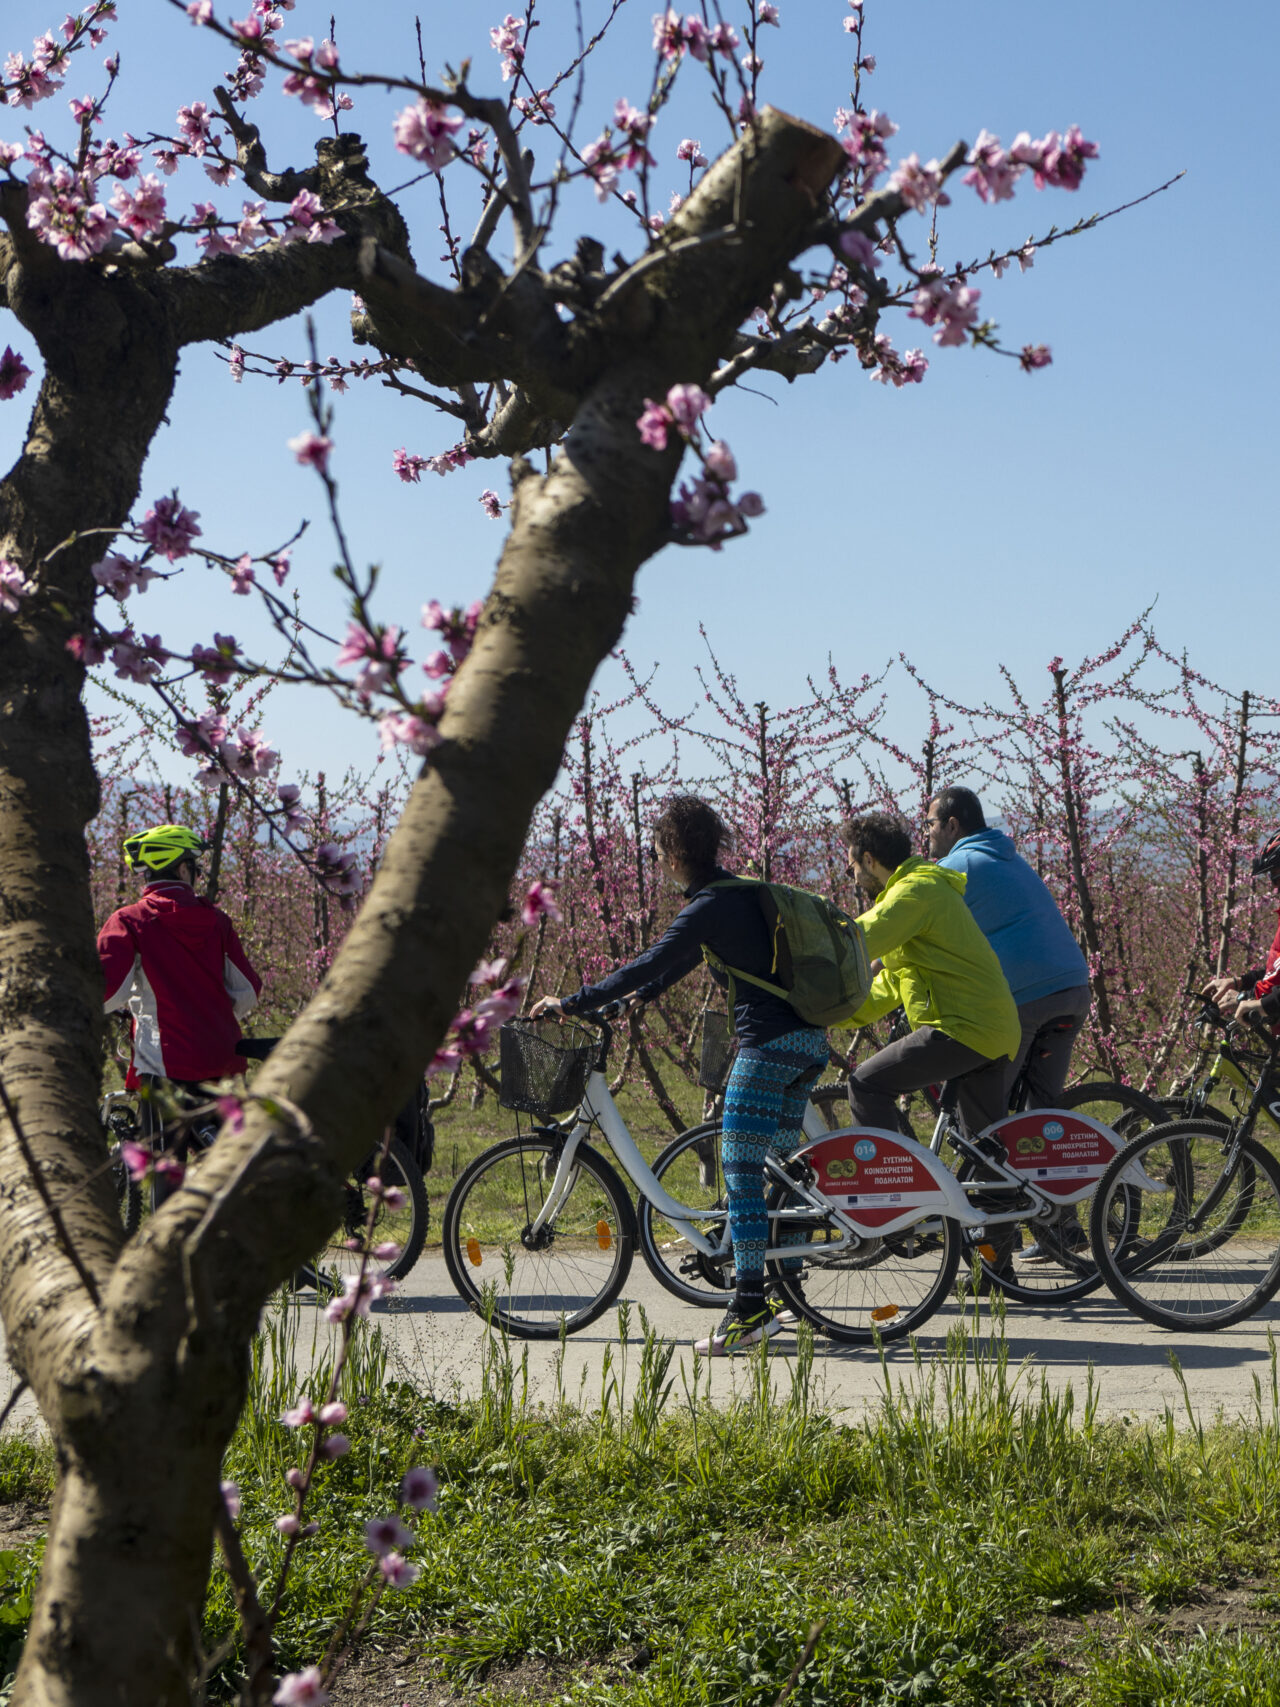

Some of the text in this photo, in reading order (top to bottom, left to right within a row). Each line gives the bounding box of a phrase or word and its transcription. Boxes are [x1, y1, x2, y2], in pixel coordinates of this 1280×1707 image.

[1044, 1125, 1063, 1135] 006
[1070, 1132, 1098, 1140] ΣΥΣΤΗΜΑ
[856, 1144, 875, 1156] 014
[1052, 1141, 1099, 1150] ΚΟΙΝΟΧΡΗΣΤΩΝ
[1062, 1150, 1099, 1159] ΠΟΔΗΛΑΤΩΝ
[883, 1155, 912, 1164] ΣΥΣΤΗΜΑ
[864, 1166, 913, 1175] ΚΟΙΝΟΧΡΗΣΤΩΝ
[874, 1176, 914, 1185] ΠΟΔΗΛΑΤΩΝ
